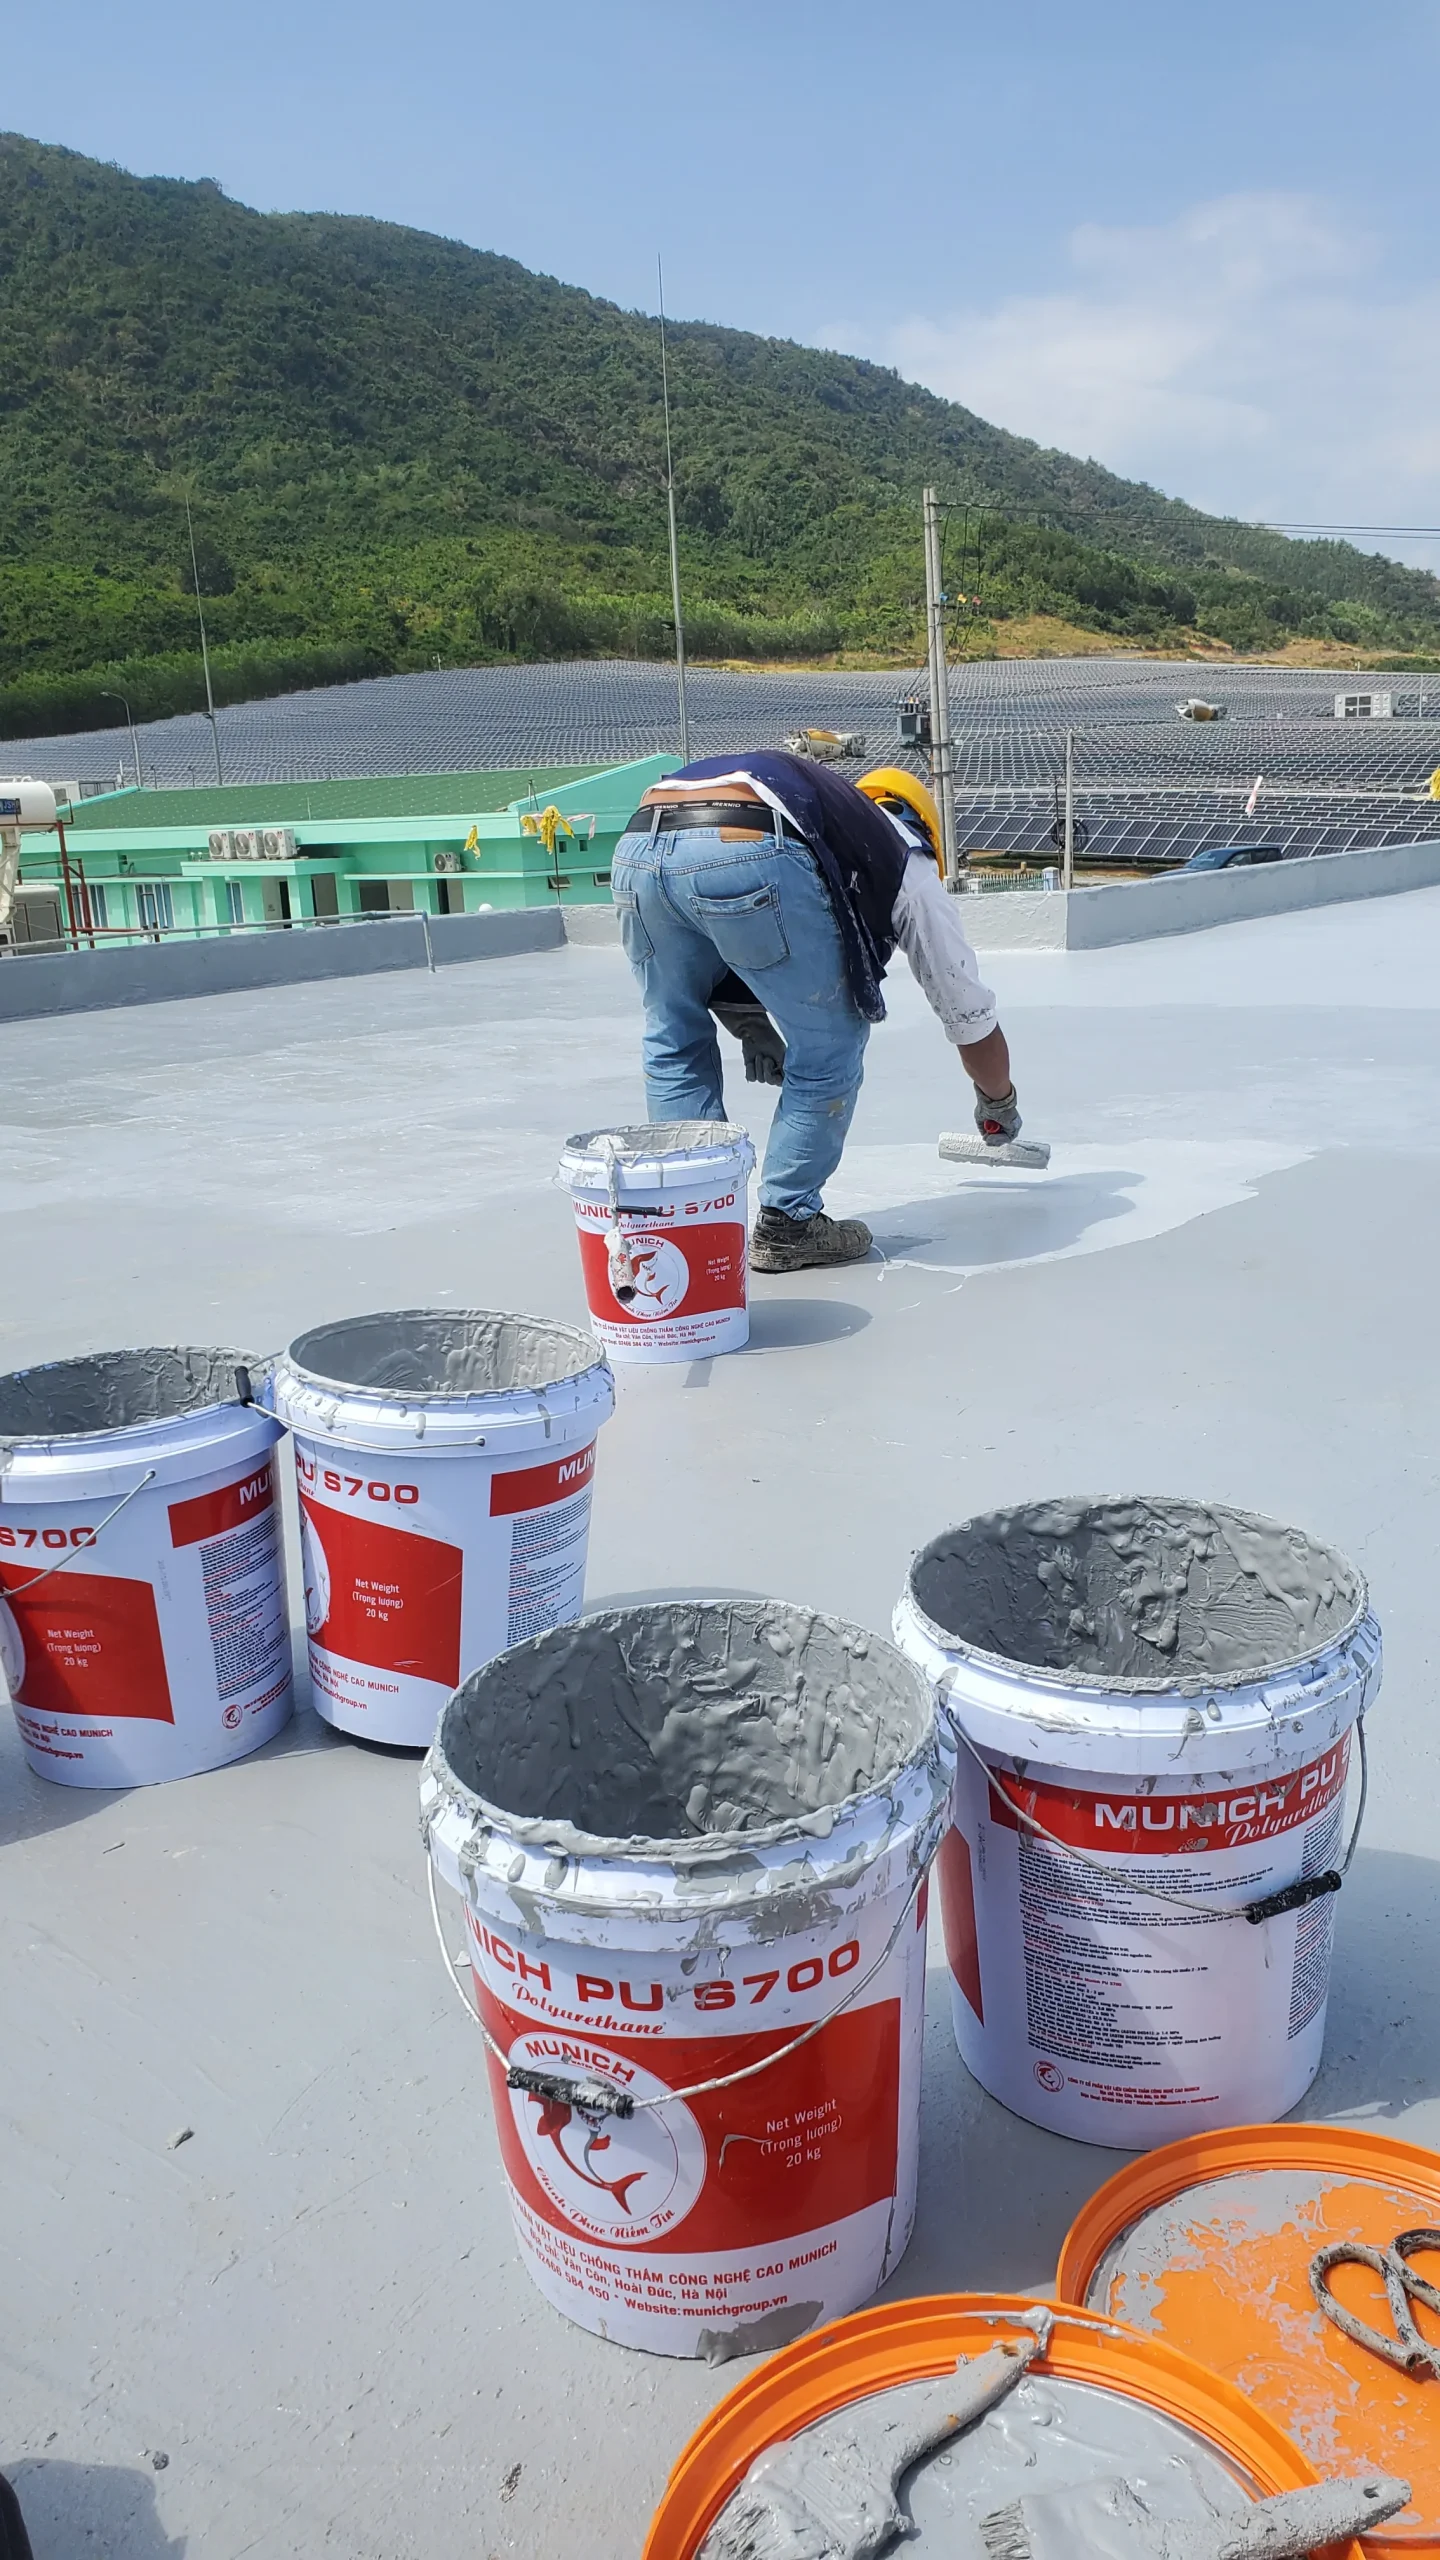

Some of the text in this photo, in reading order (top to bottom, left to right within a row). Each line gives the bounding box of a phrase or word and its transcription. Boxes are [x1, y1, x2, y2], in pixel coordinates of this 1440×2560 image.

[684, 1193, 735, 1215] S700
[323, 1470, 420, 1505] S700
[355, 1577, 400, 1594] Net Weight
[366, 1608, 389, 1621] 20 kg
[47, 1629, 95, 1640] Net Weight
[63, 1657, 89, 1668] 20 kg
[350, 1676, 365, 1688] CAO
[367, 1680, 399, 1694] MUNICH
[1301, 1753, 1336, 1800] PU
[575, 1973, 664, 2012] PU
[693, 1939, 860, 2012] S700
[511, 1982, 666, 2035] Polyurethane
[525, 2039, 635, 2083] MUNICH
[766, 2098, 837, 2133] Net Weight
[760, 2134, 802, 2156] (Trọng
[786, 2146, 821, 2168] 20 kg
[650, 2208, 675, 2229] Tin
[554, 2236, 575, 2257] LIỆU
[579, 2251, 621, 2275] CHỐNG
[669, 2272, 708, 2286] CÔNG
[713, 2268, 751, 2284] NGHỆ
[756, 2262, 784, 2279] CAO
[788, 2239, 837, 2270] MUNICH
[565, 2271, 585, 2291] 584
[587, 2285, 610, 2301] 450
[624, 2295, 682, 2317] Website:
[683, 2295, 788, 2317] munichgroup.vn
[585, 2266, 611, 2288] Côn,
[614, 2278, 642, 2295] Hoài
[647, 2285, 676, 2301] Đức,
[682, 2288, 700, 2300] Hà
[705, 2287, 728, 2301] Nội
